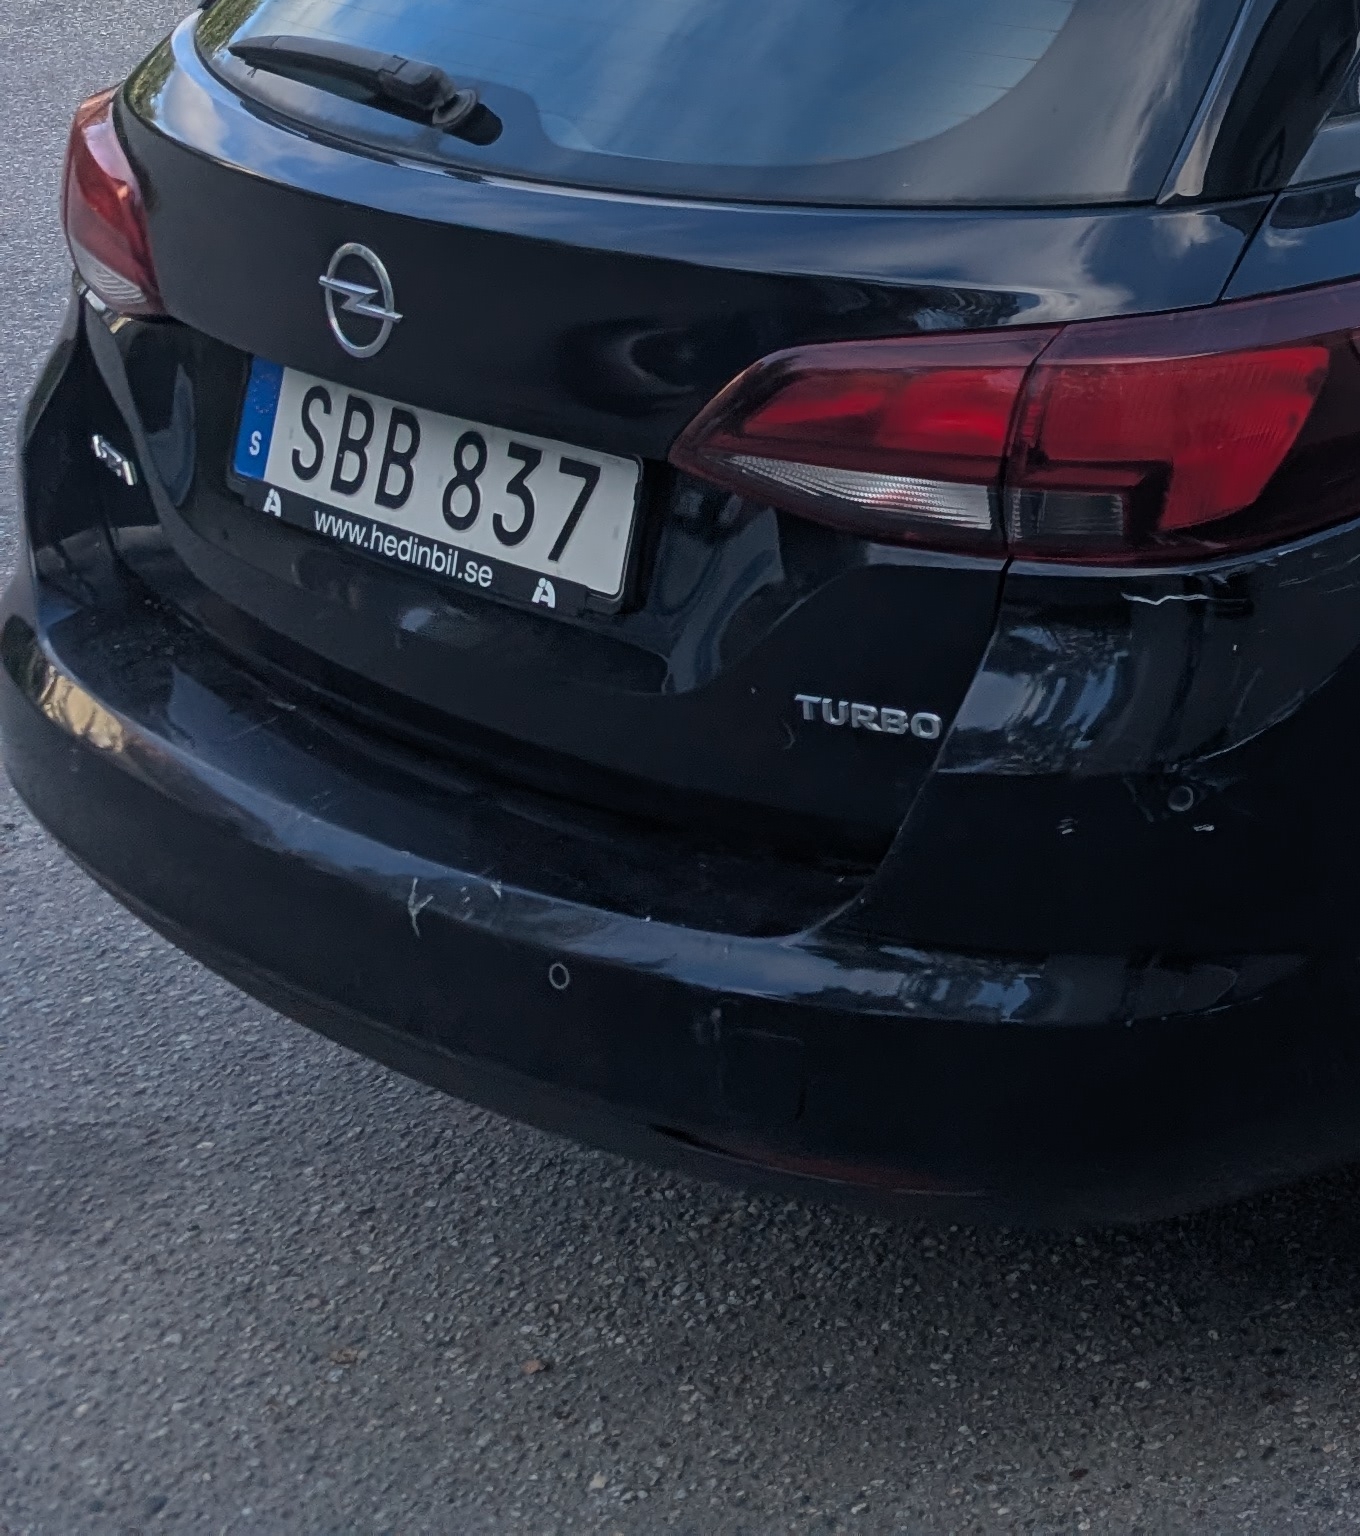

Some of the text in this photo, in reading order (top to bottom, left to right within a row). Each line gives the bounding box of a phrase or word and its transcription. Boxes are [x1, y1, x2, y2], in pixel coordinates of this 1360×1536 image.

[249, 431, 263, 456] S
[291, 385, 421, 510] SBB
[441, 431, 602, 562] 837
[314, 510, 493, 588] www.hedinbil.se
[794, 694, 943, 740] TURBO
